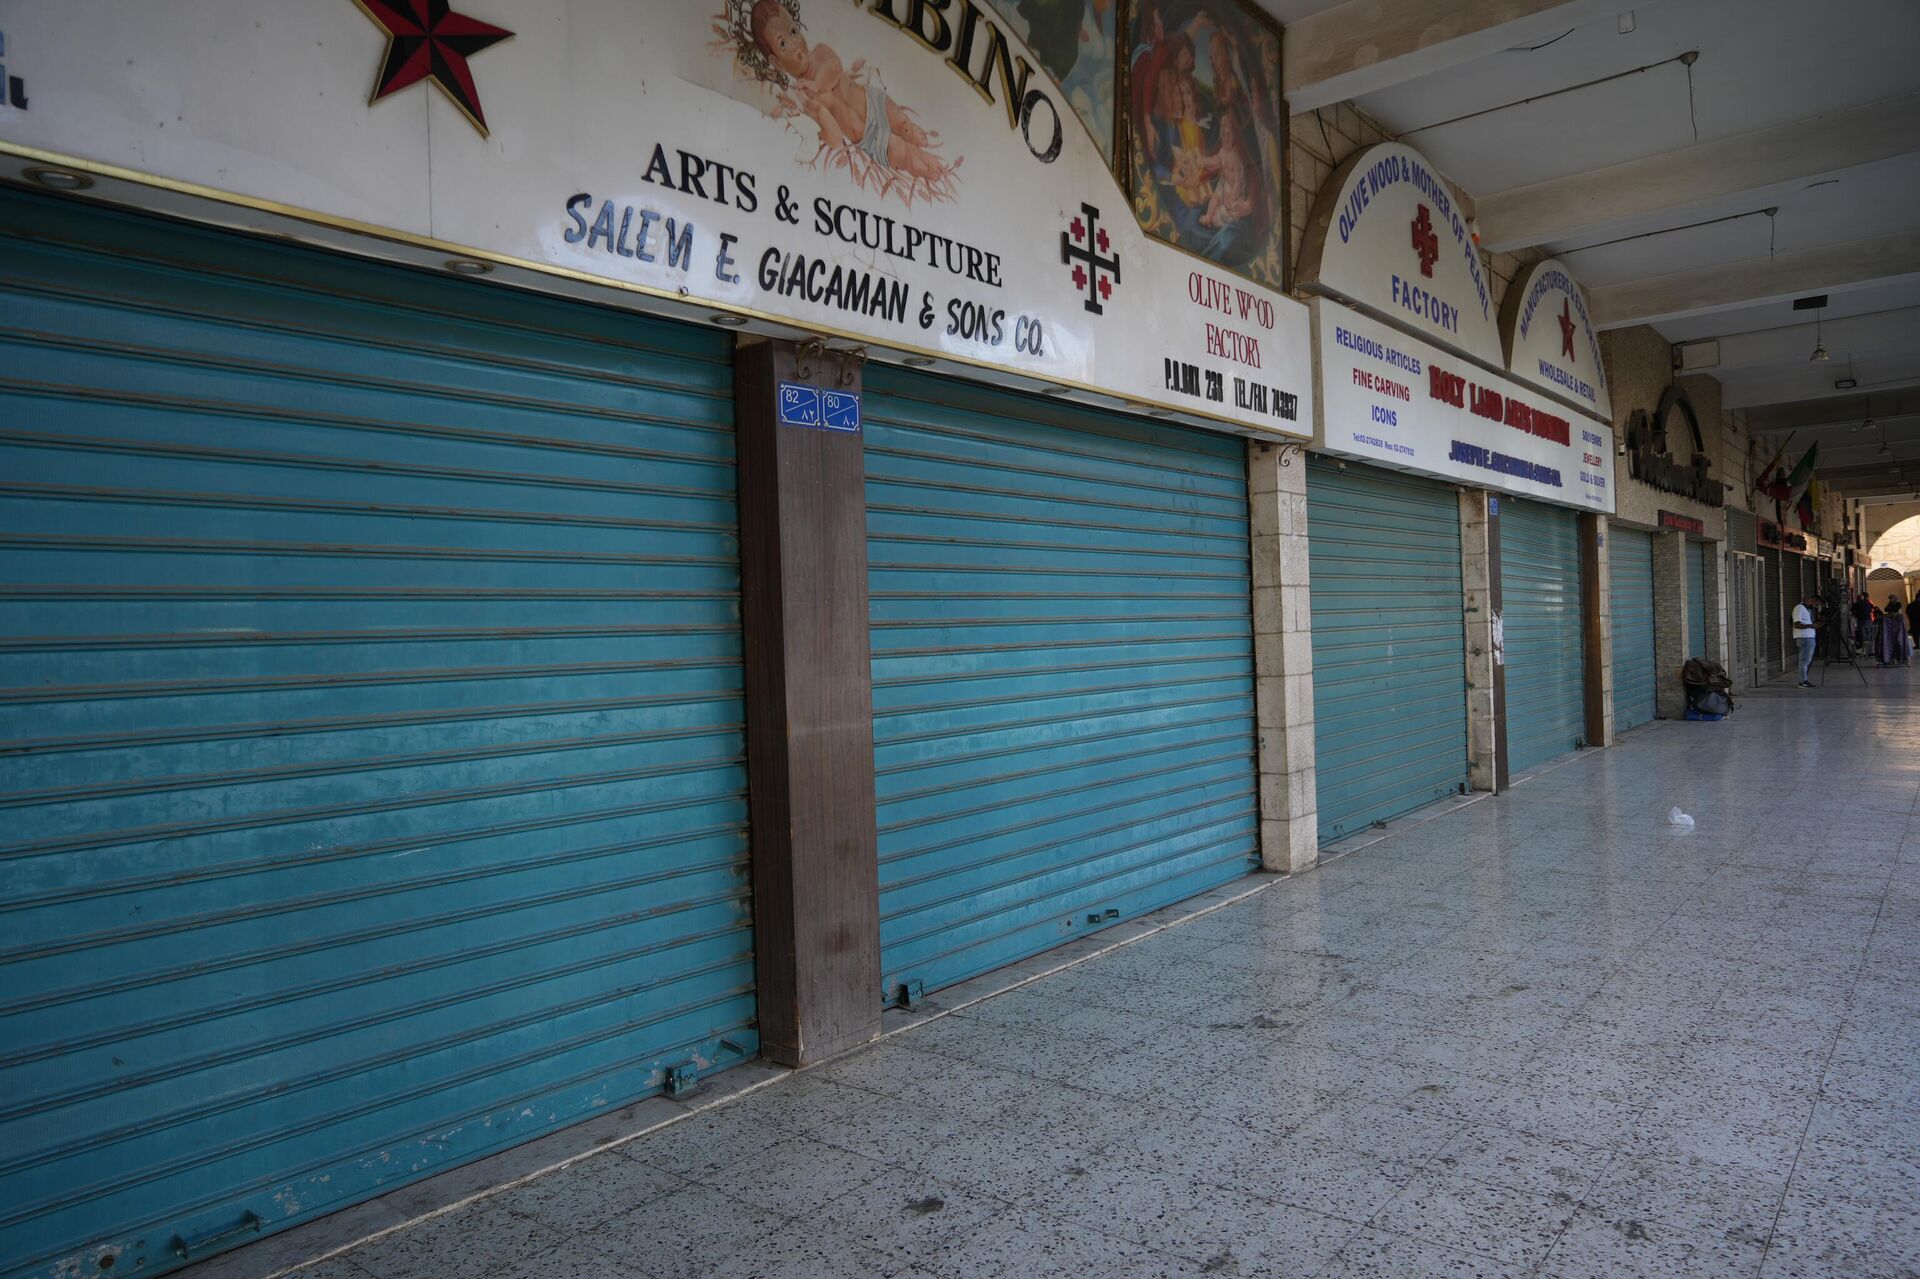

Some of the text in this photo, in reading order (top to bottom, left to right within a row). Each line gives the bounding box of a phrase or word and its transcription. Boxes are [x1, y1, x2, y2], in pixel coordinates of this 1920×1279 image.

[854, 0, 1063, 164] BINO
[641, 142, 1003, 288] ARTS & SCULPTURE
[1339, 156, 1489, 322] OLIVE WOOD & MOTHER OF PEARL
[564, 192, 1044, 358] SALEM E. GIACAMAN & SONS CO.
[1188, 271, 1232, 316] OLIVE
[1391, 274, 1459, 334] FACTORY
[1335, 326, 1421, 376] RELIGIOUS ARTICLES
[1538, 358, 1574, 391] WHOLESALE
[785, 389, 799, 404] 82
[827, 395, 840, 409] 80
[1352, 368, 1410, 402] FINE CARVING
[1371, 404, 1397, 427] ICONS
